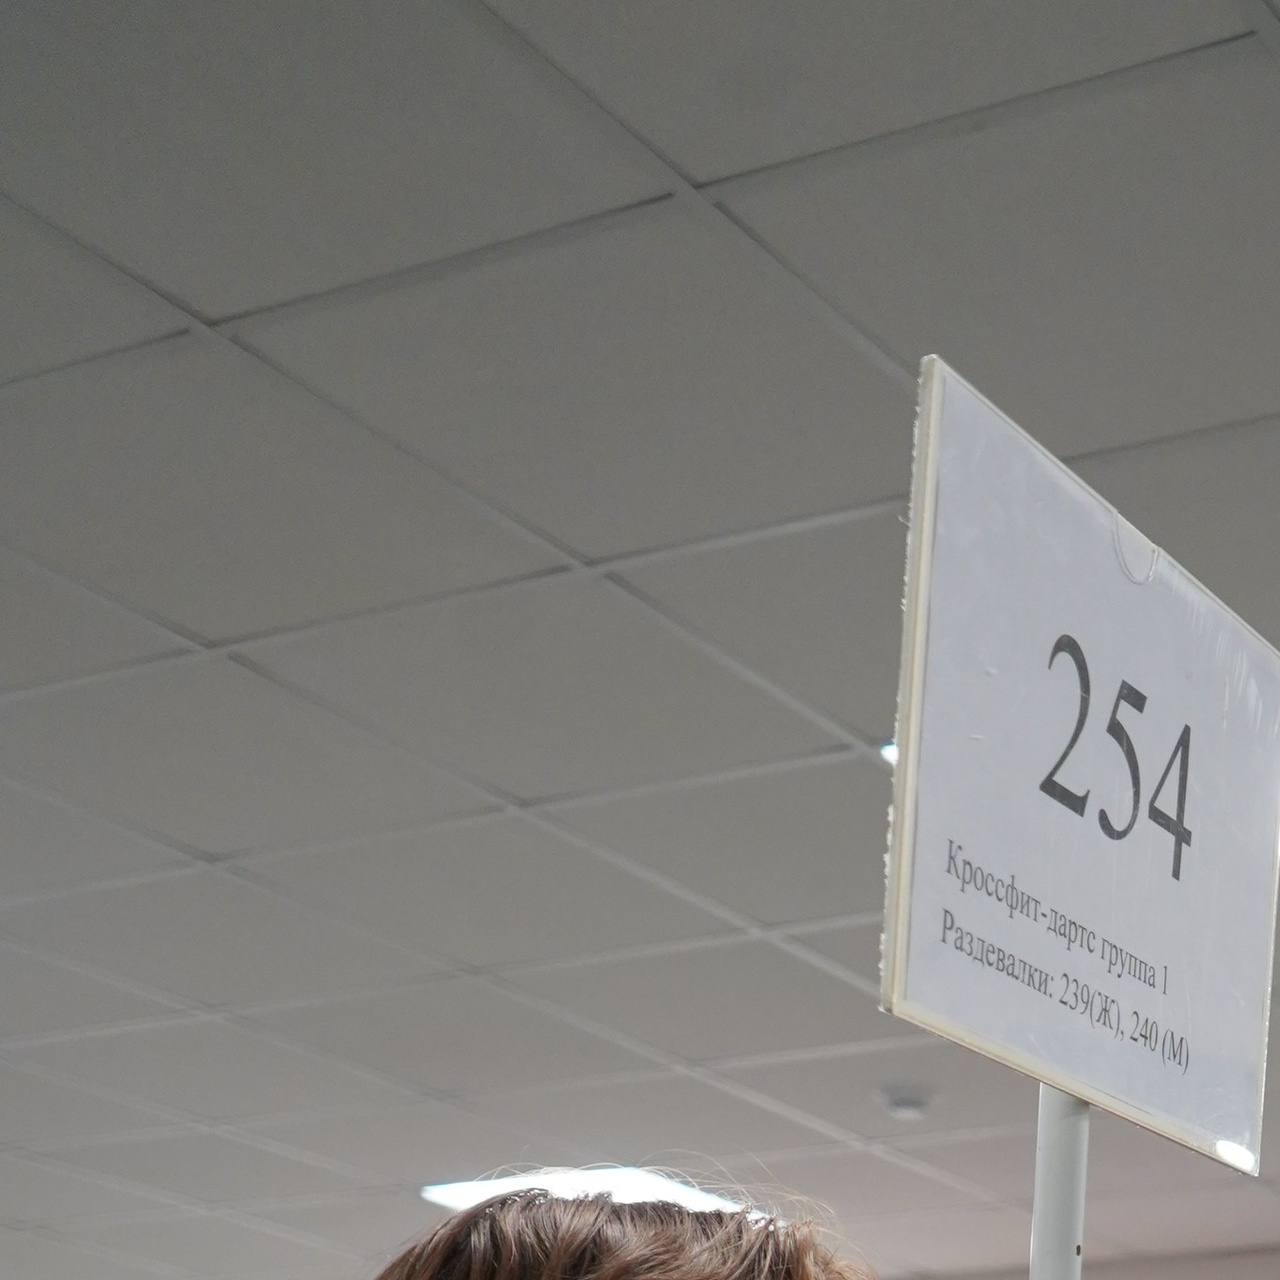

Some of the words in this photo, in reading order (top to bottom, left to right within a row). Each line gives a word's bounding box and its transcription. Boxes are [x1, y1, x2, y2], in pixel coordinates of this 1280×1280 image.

[1038, 634, 1192, 882] 254
[940, 908, 1055, 998] Раздевалки:
[1058, 973, 1125, 1042] 239(Ж),
[1129, 1011, 1158, 1052] 240
[1162, 1028, 1190, 1075] (М)
[945, 839, 1096, 953] Кроссфит-дартс
[1100, 937, 1156, 988] группа
[1162, 966, 1168, 996] 1
